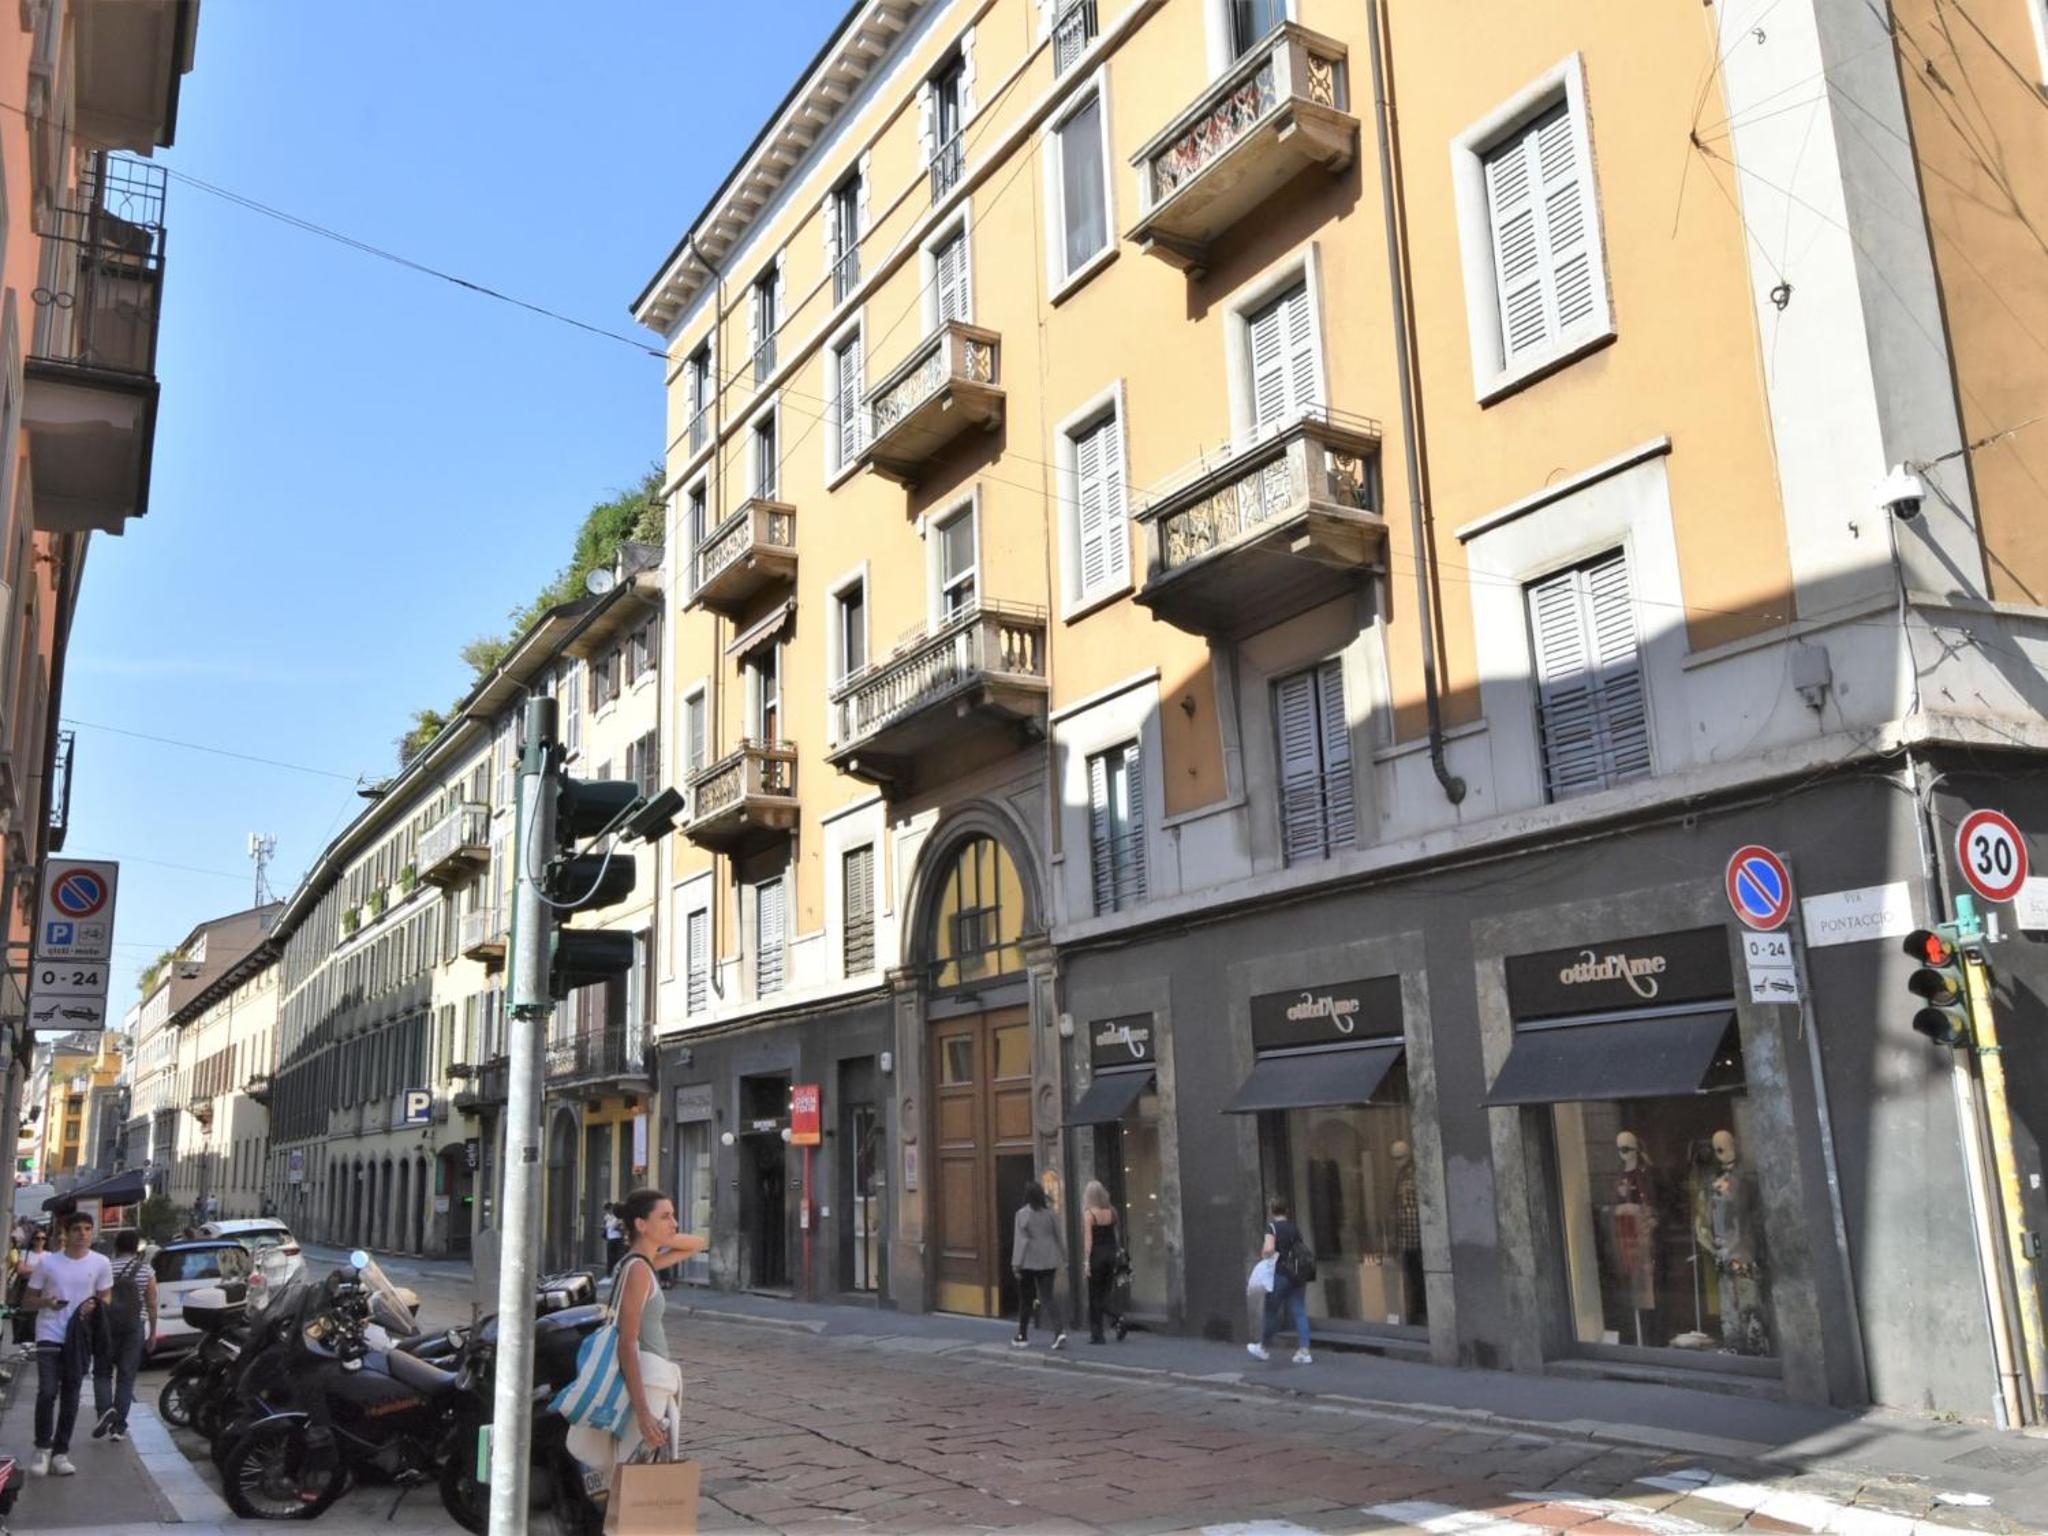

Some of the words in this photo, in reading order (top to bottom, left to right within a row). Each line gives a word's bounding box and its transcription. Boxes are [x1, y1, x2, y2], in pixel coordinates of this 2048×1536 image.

[1975, 835, 2012, 876] 30
[1843, 892, 1863, 904] VIA
[1820, 911, 1895, 933] PONTACCIO
[52, 925, 69, 943] P
[1750, 941, 1759, 956] 0
[1769, 942, 1786, 957] 24
[42, 970, 55, 985] 0
[72, 971, 98, 986] 24
[408, 1092, 430, 1117] P
